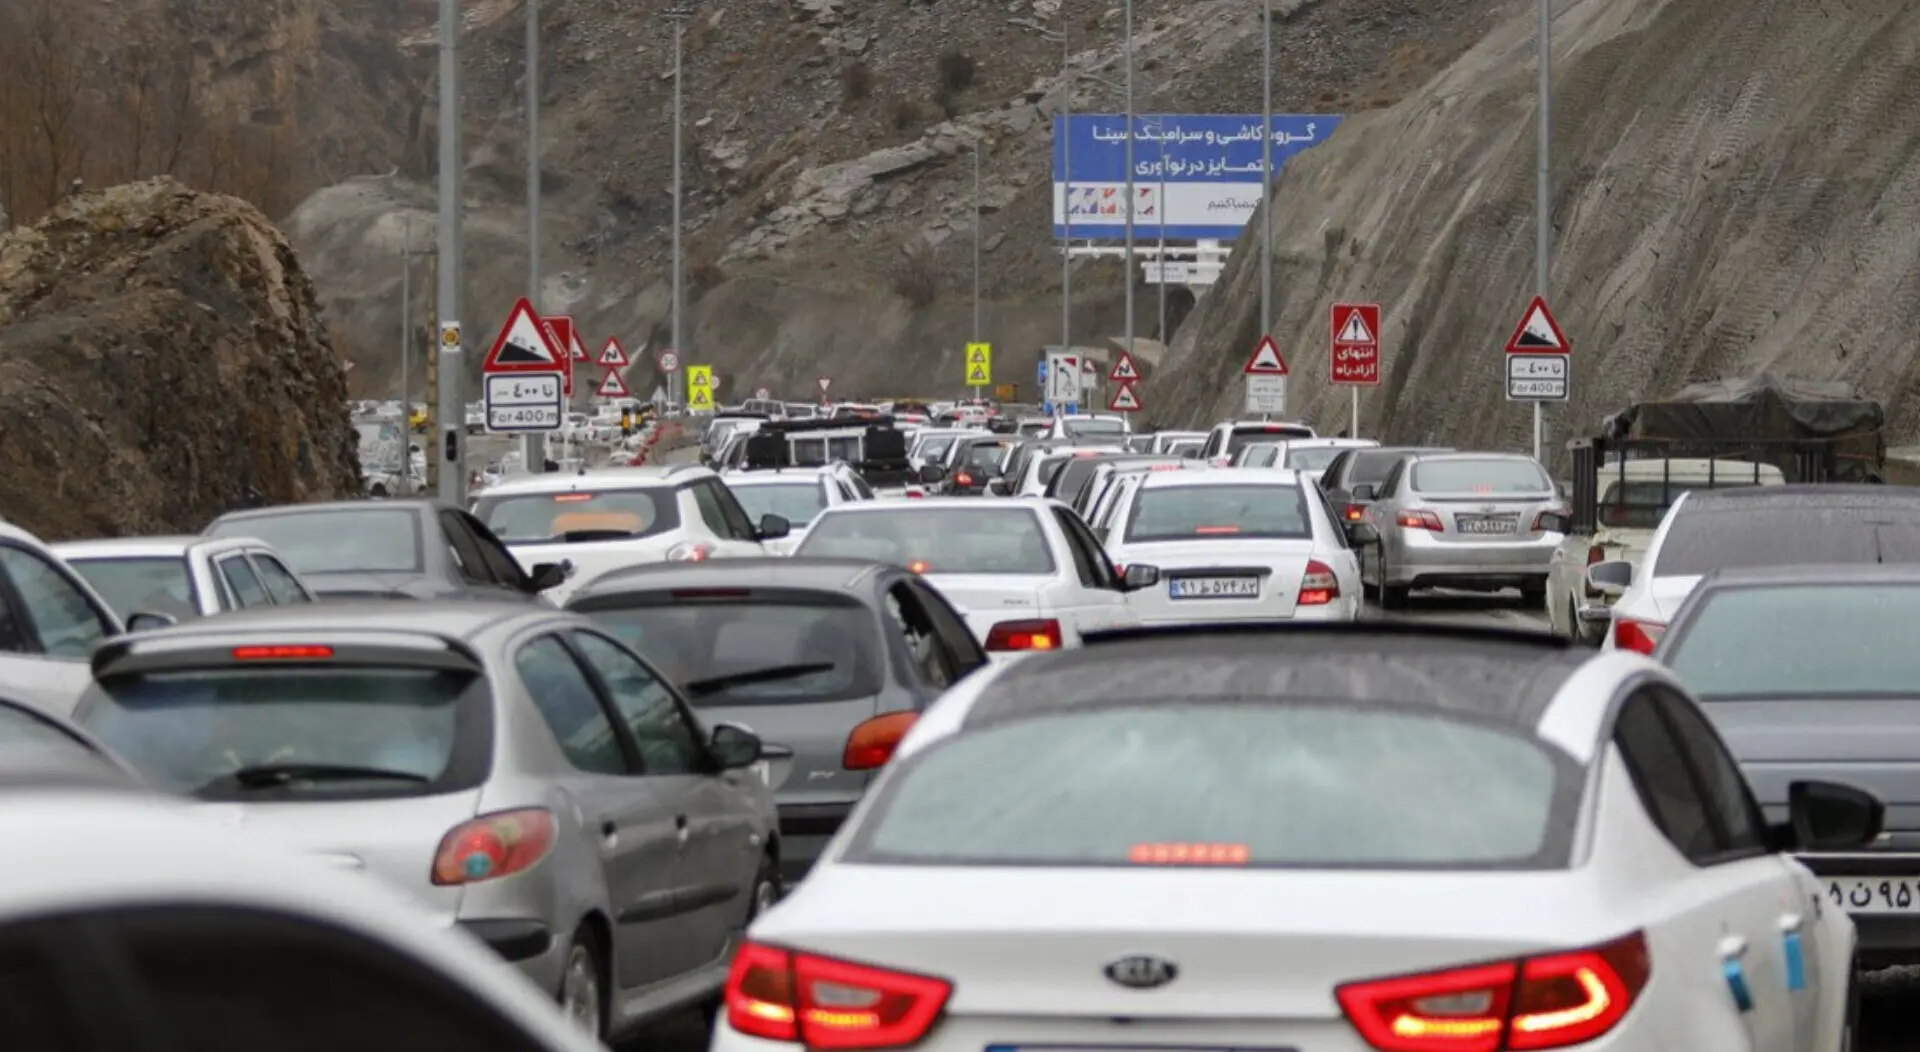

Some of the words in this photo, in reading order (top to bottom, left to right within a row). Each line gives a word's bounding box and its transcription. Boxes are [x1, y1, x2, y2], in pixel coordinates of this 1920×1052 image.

[1092, 124, 1129, 145] سینا
[1133, 124, 1203, 146] سرامیک
[1205, 130, 1215, 146] و
[1217, 123, 1264, 145] کاشی
[1135, 154, 1187, 177] نوآوری
[1187, 159, 1205, 176] در
[1206, 156, 1275, 176] تمایز
[1337, 347, 1374, 361] انتهای
[1529, 381, 1553, 393] 400
[490, 410, 513, 422] For
[514, 409, 544, 422] 400
[546, 411, 558, 422] m
[1849, 881, 1872, 908] ن
[1879, 880, 1920, 908] ۹۵
